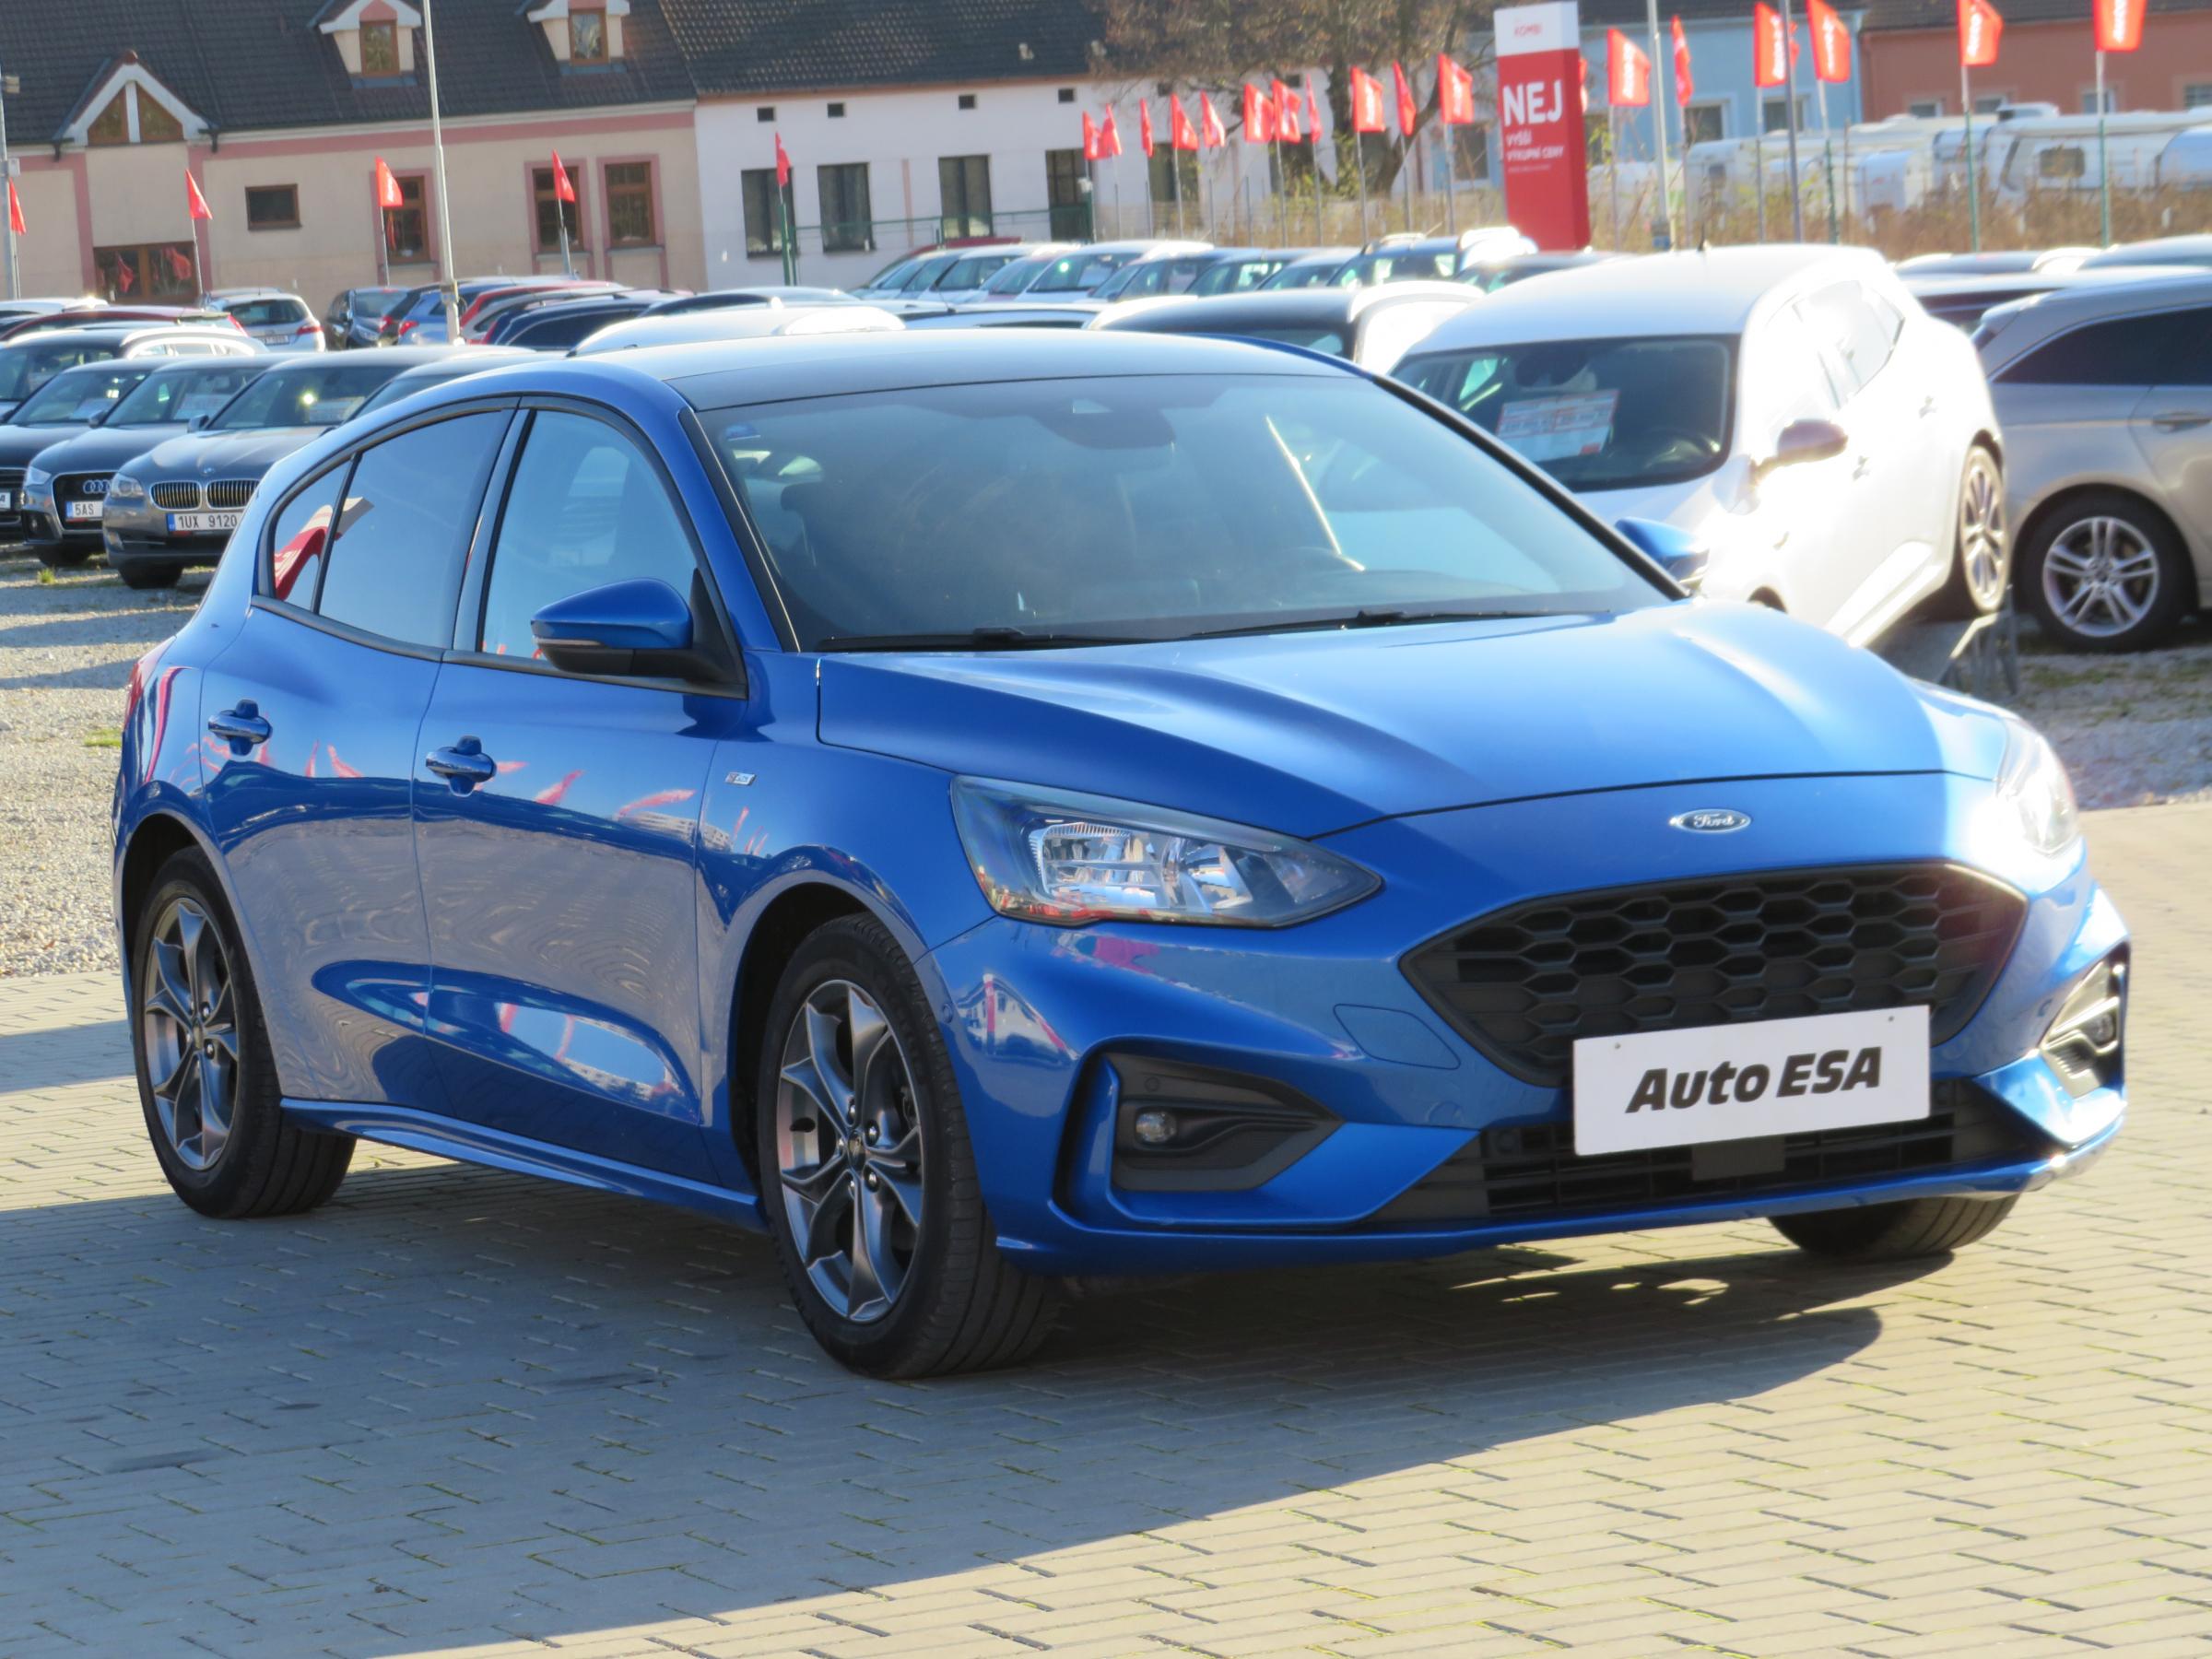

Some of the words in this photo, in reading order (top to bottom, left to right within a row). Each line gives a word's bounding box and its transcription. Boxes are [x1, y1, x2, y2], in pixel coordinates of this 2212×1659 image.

[1502, 79, 1563, 126] NEJ
[75, 503, 94, 516] 5AS
[178, 515, 199, 529] 1UX
[208, 513, 238, 528] 9120
[1694, 812, 1734, 828] Ford
[1625, 1061, 1770, 1113] Auto
[1776, 1046, 1882, 1098] ESA
